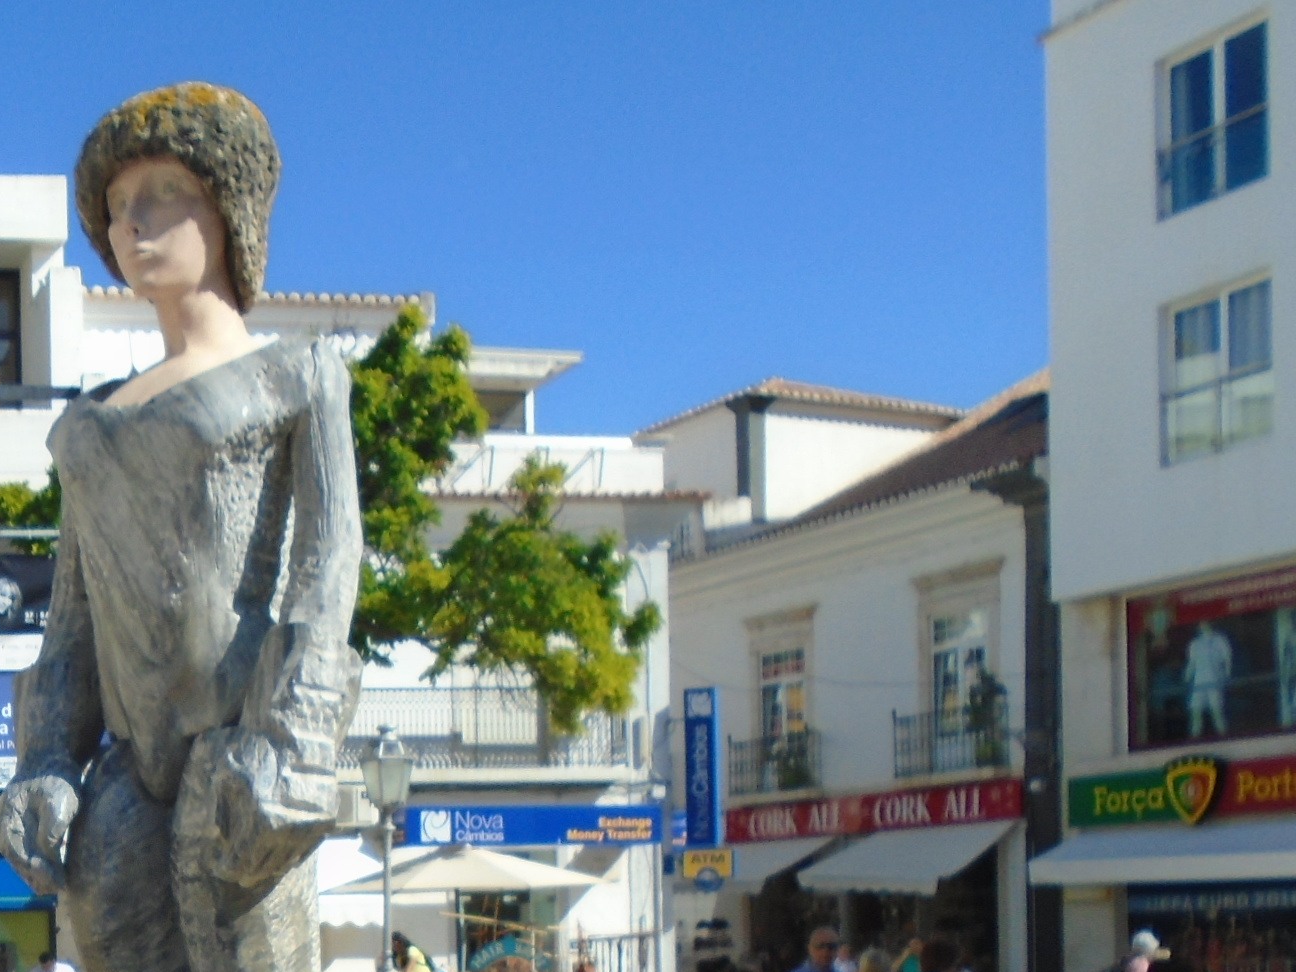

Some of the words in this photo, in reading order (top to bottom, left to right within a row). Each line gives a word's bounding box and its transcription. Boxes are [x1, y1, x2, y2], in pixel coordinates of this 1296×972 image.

[872, 793, 932, 828] CORK
[945, 786, 986, 820] ALL
[1093, 785, 1166, 819] Força
[455, 811, 504, 830] Nova
[599, 816, 653, 831] Exchange
[749, 807, 797, 838] CORK
[567, 828, 604, 842] Money
[608, 828, 653, 840] Transfer
[691, 853, 726, 865] ATM
